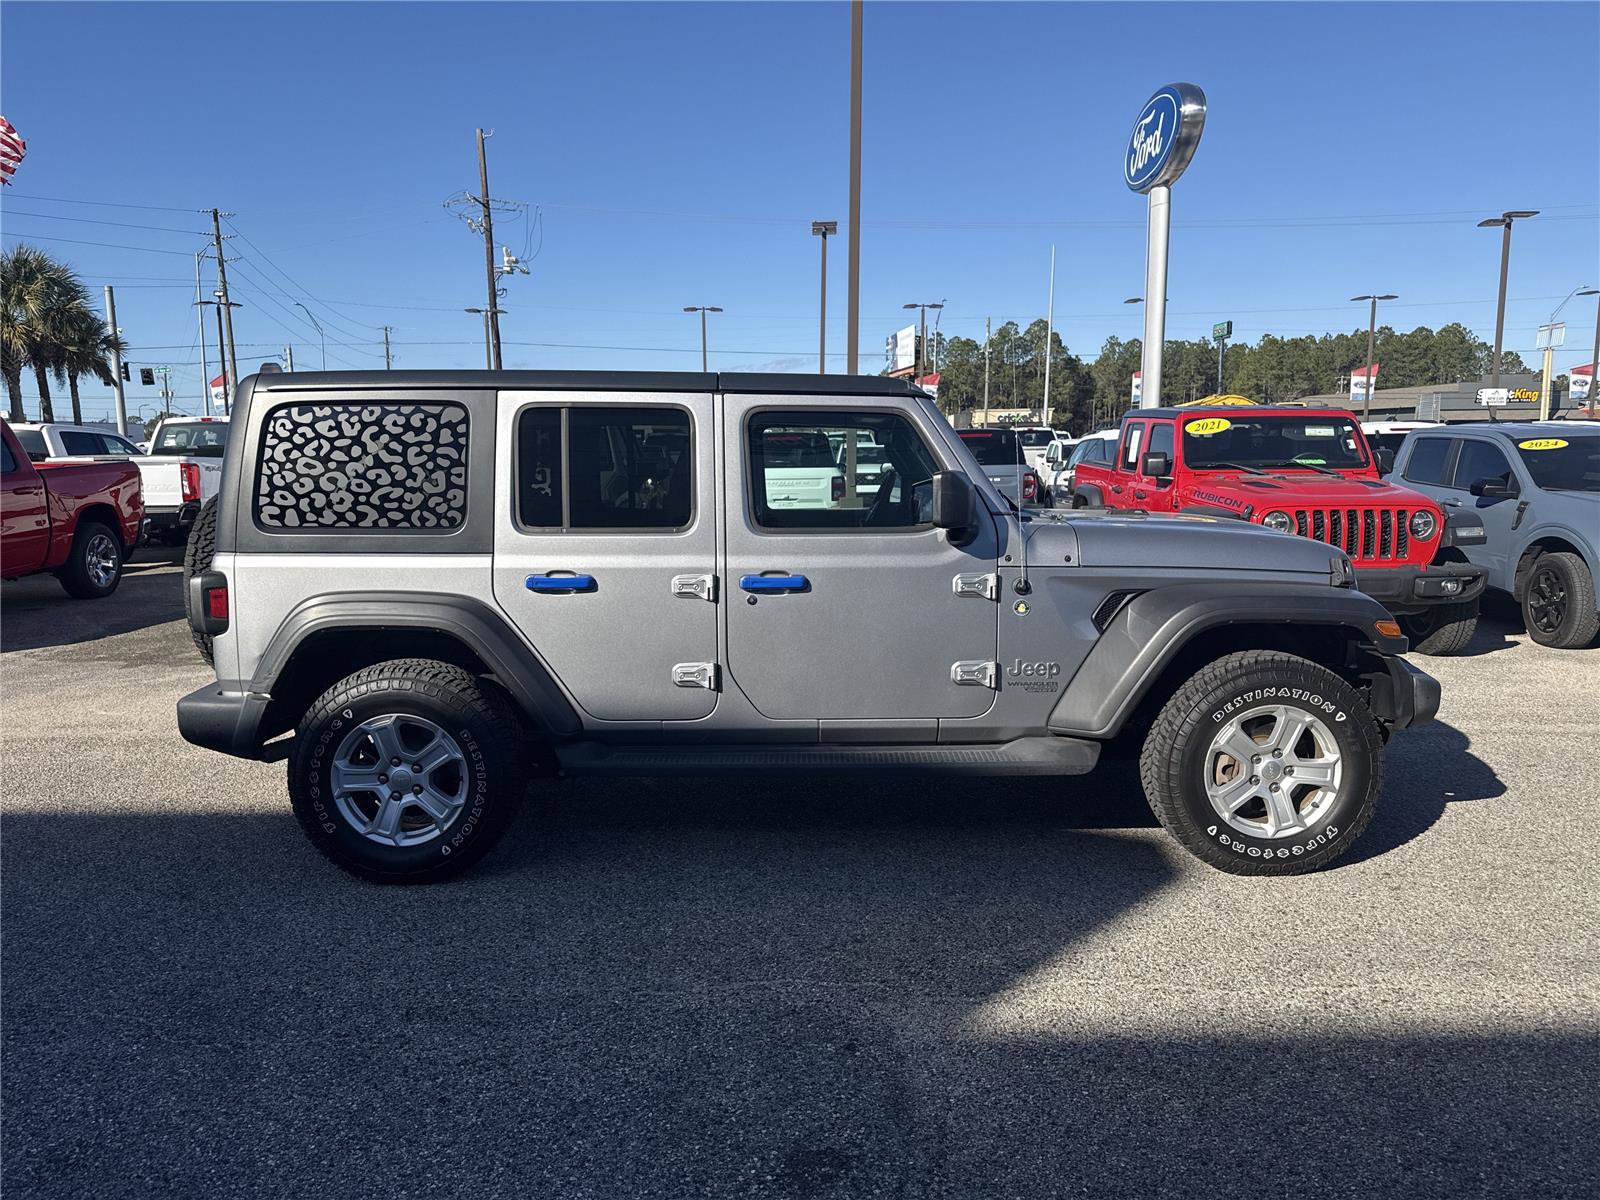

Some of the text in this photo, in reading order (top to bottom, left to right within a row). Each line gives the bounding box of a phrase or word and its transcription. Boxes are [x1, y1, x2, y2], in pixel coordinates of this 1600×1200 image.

[1130, 109, 1165, 177] Ford
[1194, 421, 1222, 432] 2021
[1193, 489, 1243, 508] RUBICON
[1006, 658, 1061, 679] Jeep
[1212, 686, 1336, 723] DESTINATION
[452, 728, 487, 847] DESTINATION
